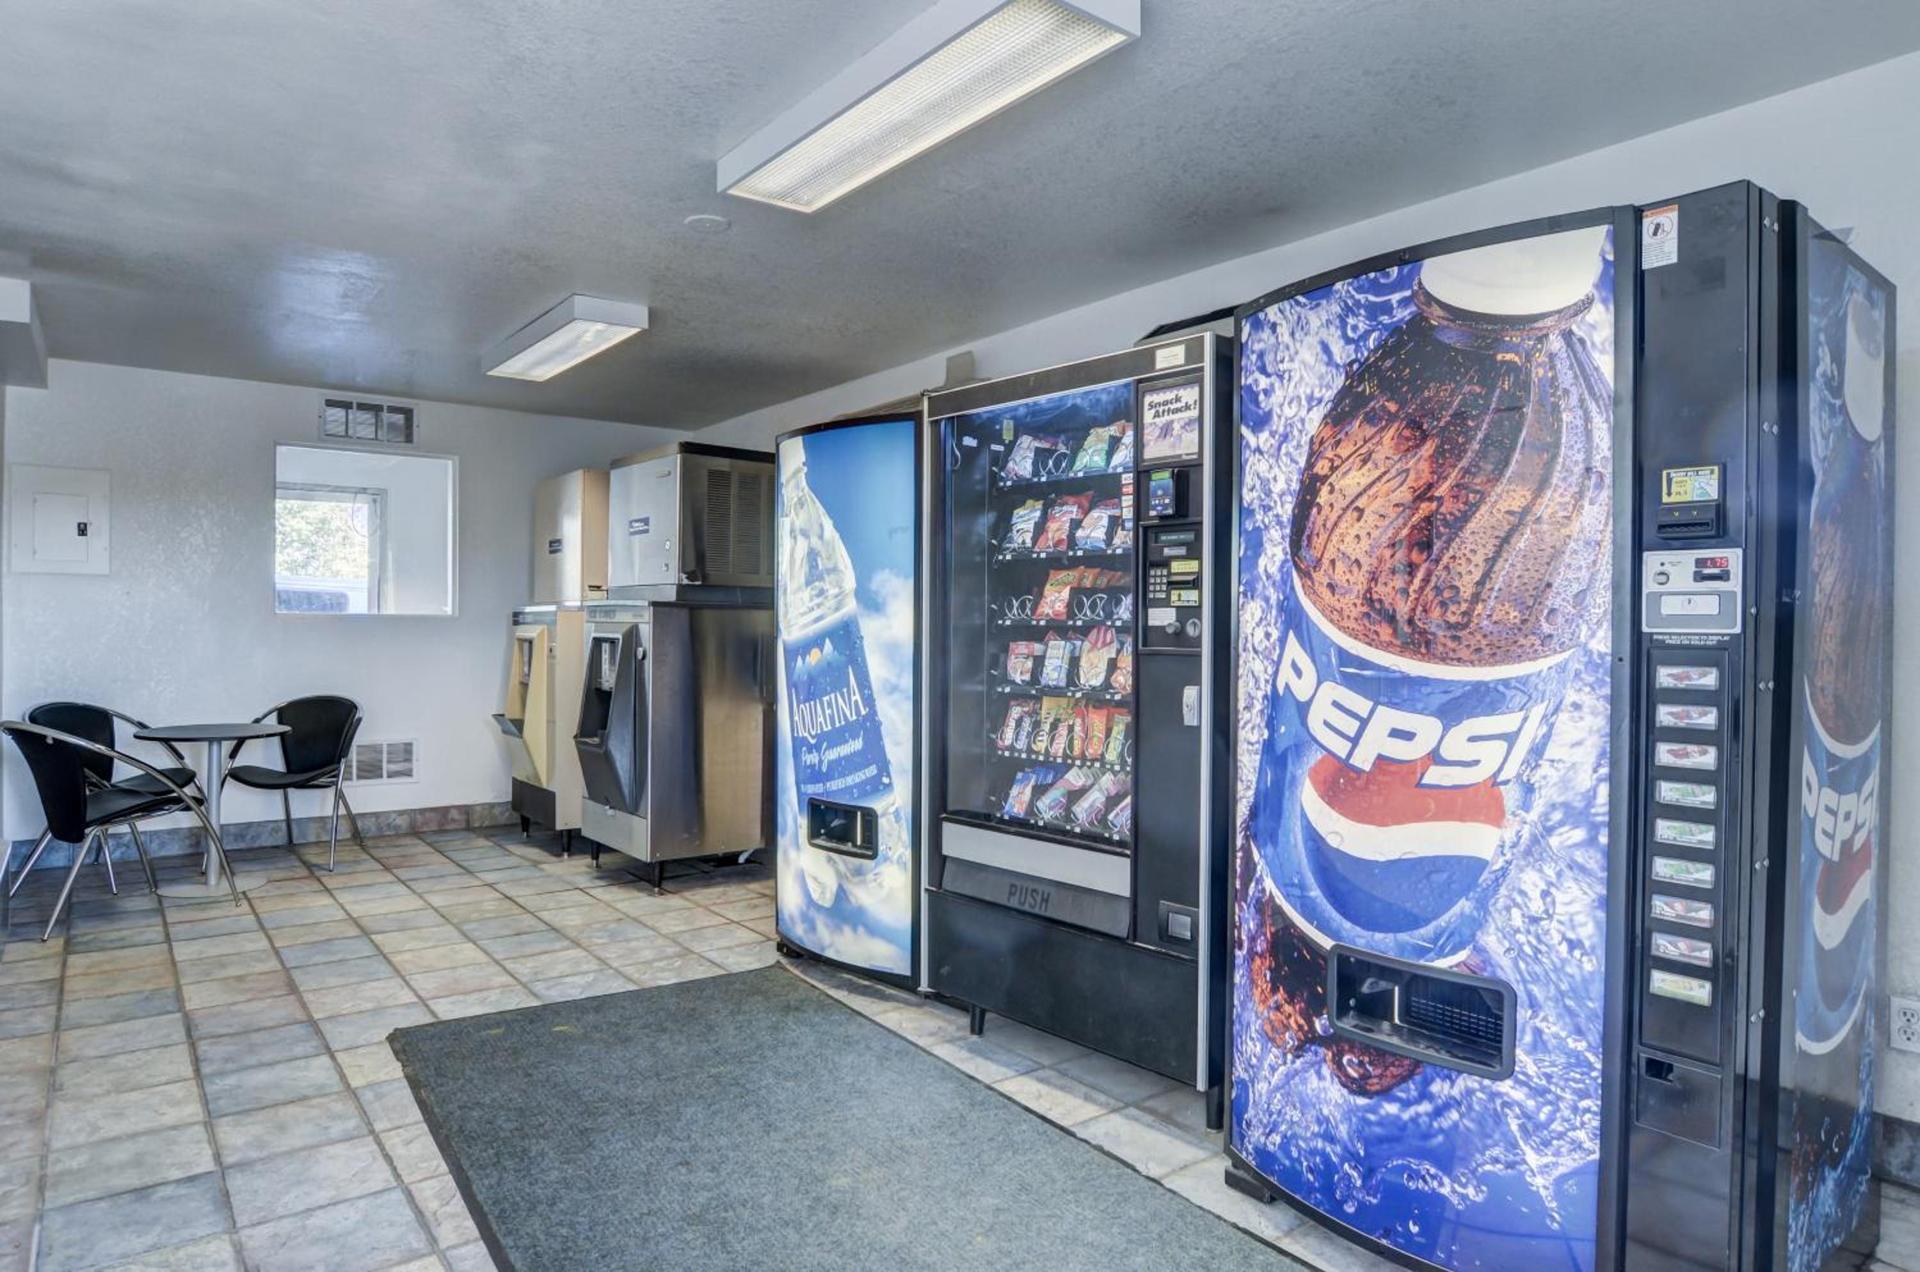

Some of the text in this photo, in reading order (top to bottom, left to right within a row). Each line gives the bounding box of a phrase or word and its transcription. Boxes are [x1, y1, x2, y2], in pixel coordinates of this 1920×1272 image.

[1147, 393, 1182, 411] Snack
[1151, 399, 1198, 420] Attack!
[793, 666, 868, 743] AQUAFINA
[1276, 629, 1549, 787] PEPSI
[1007, 883, 1050, 912] PUSH
